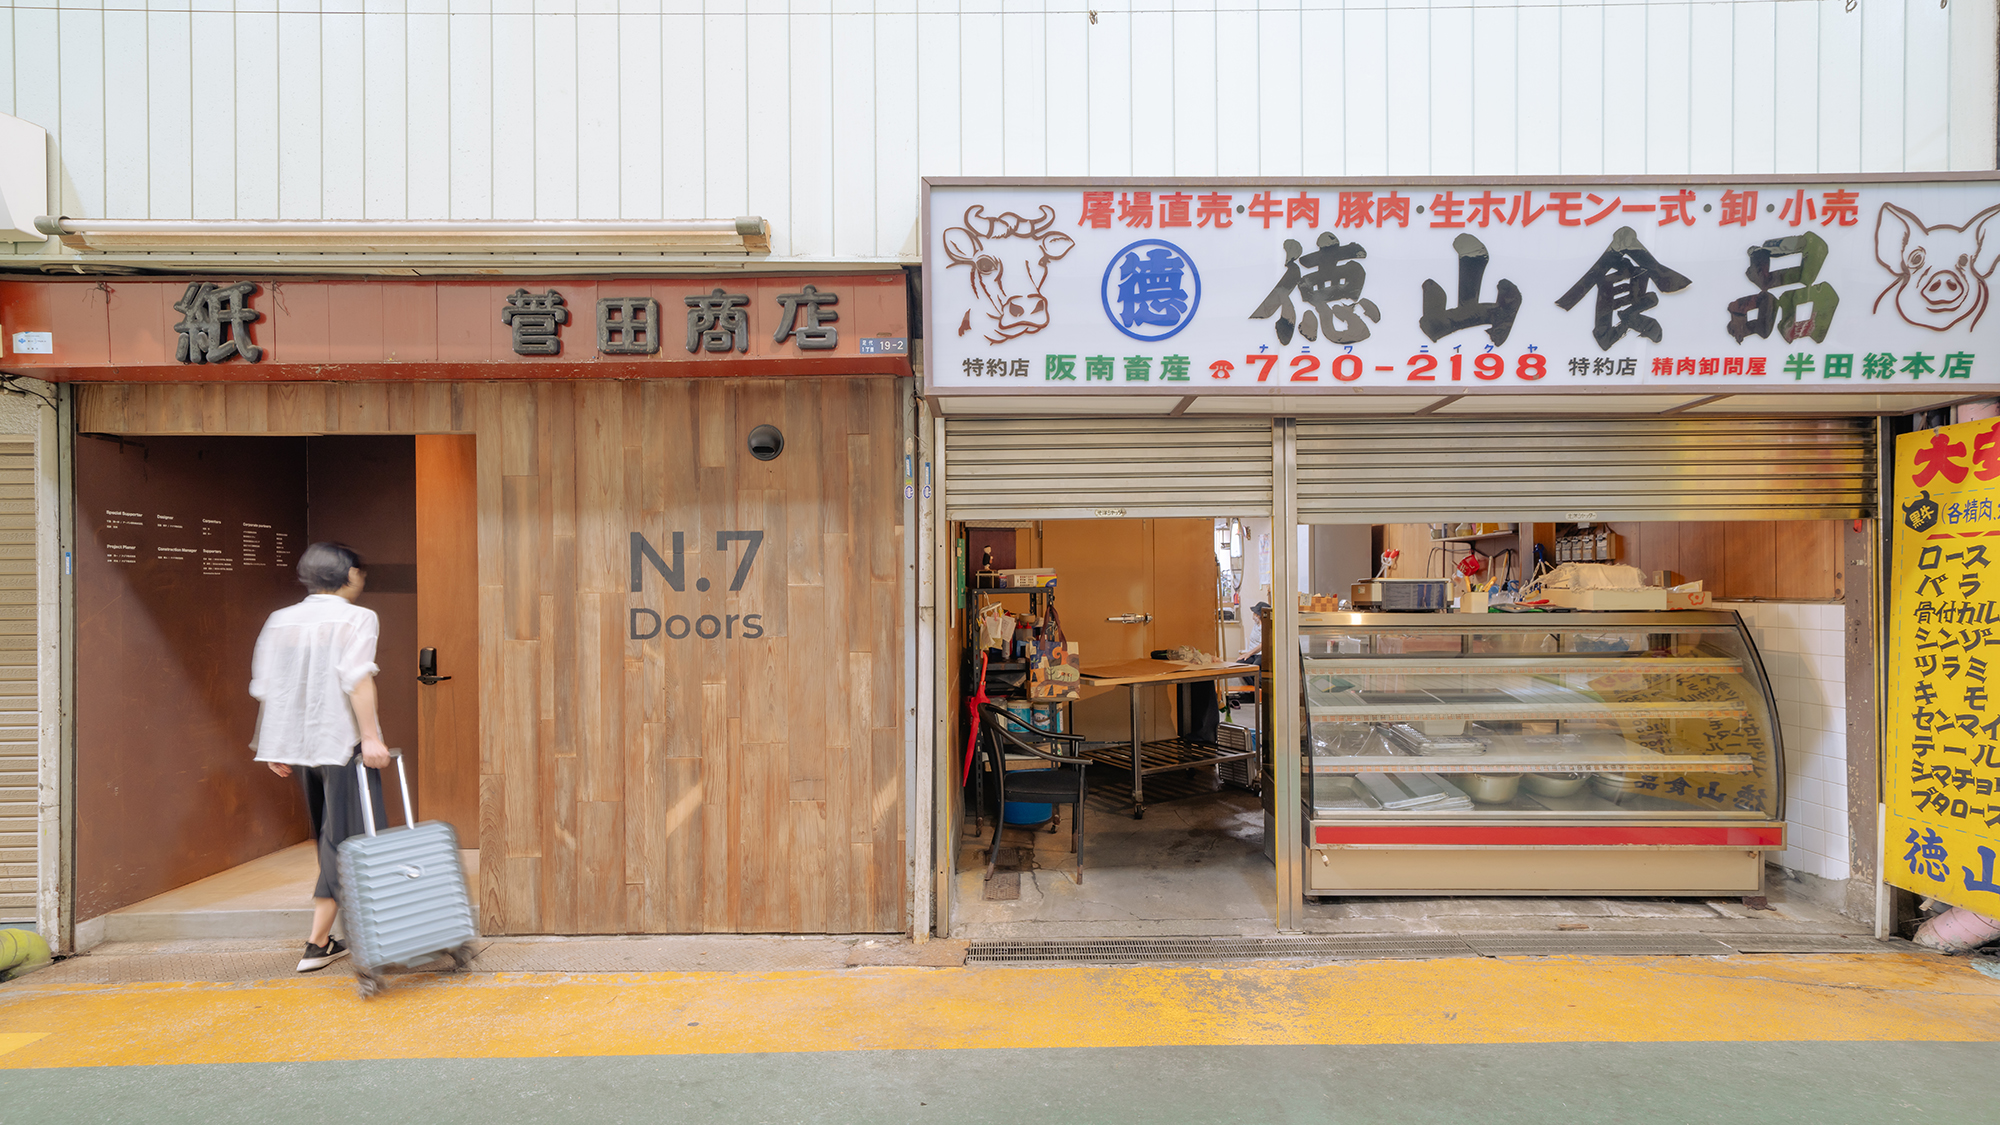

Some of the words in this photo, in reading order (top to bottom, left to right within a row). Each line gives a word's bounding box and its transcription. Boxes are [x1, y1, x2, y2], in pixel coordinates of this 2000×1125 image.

[1248, 226, 1840, 350] 徳山食品
[173, 281, 263, 364] 紙
[880, 340, 904, 351] 19-2
[962, 358, 1030, 377] 特約店
[1045, 354, 1191, 381] 阪南畜産
[1246, 353, 1547, 382] 720-2198
[1568, 357, 1637, 376] 特約店
[1651, 356, 1767, 376] 精肉卸問屋
[1784, 351, 1975, 380] 半田総本店
[630, 530, 763, 593] N.7
[1917, 545, 1991, 571] ロース
[1915, 573, 1981, 600] バラ
[630, 607, 764, 640] Doors
[1914, 654, 1988, 684] ツラミ
[1911, 706, 2000, 740] センマイ
